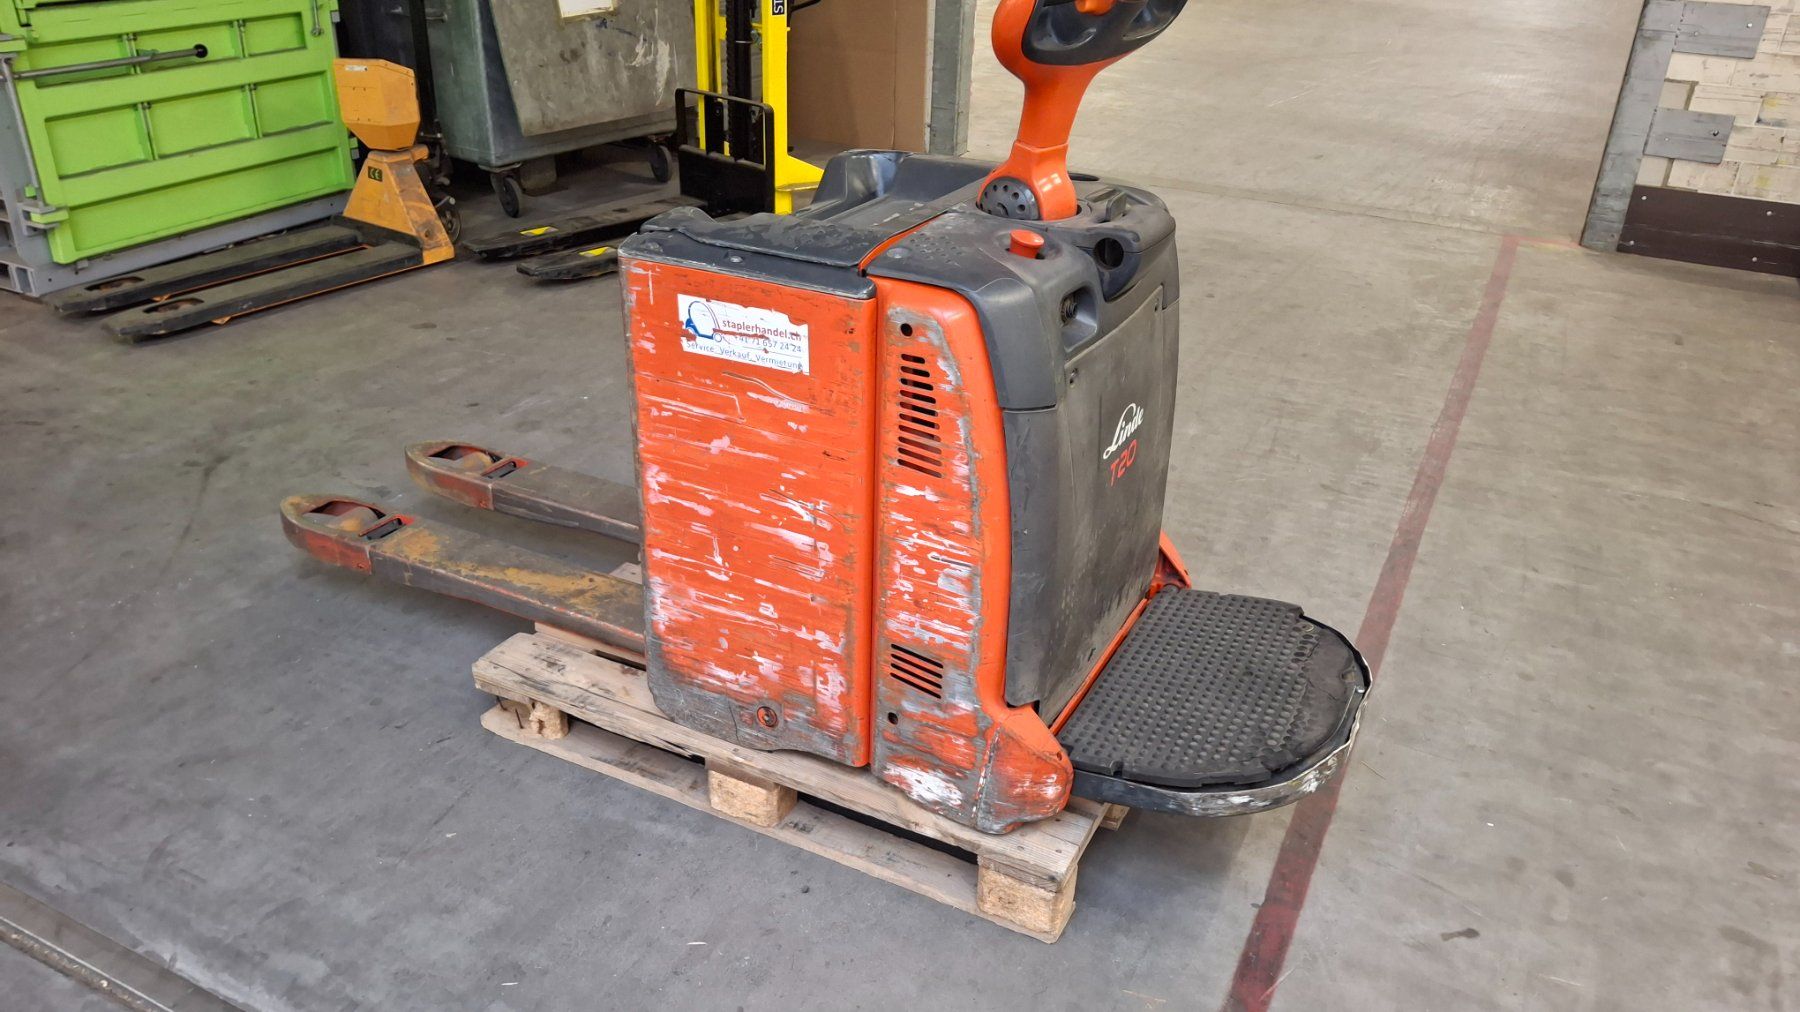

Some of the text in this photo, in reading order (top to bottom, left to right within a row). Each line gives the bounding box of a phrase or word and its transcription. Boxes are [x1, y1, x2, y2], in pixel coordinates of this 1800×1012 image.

[722, 320, 801, 341] staplerhandel.ch
[762, 339, 778, 348] 657
[780, 342, 789, 350] 24
[791, 344, 801, 353] 24
[1103, 403, 1144, 459] Linde
[1110, 439, 1137, 487] T20
